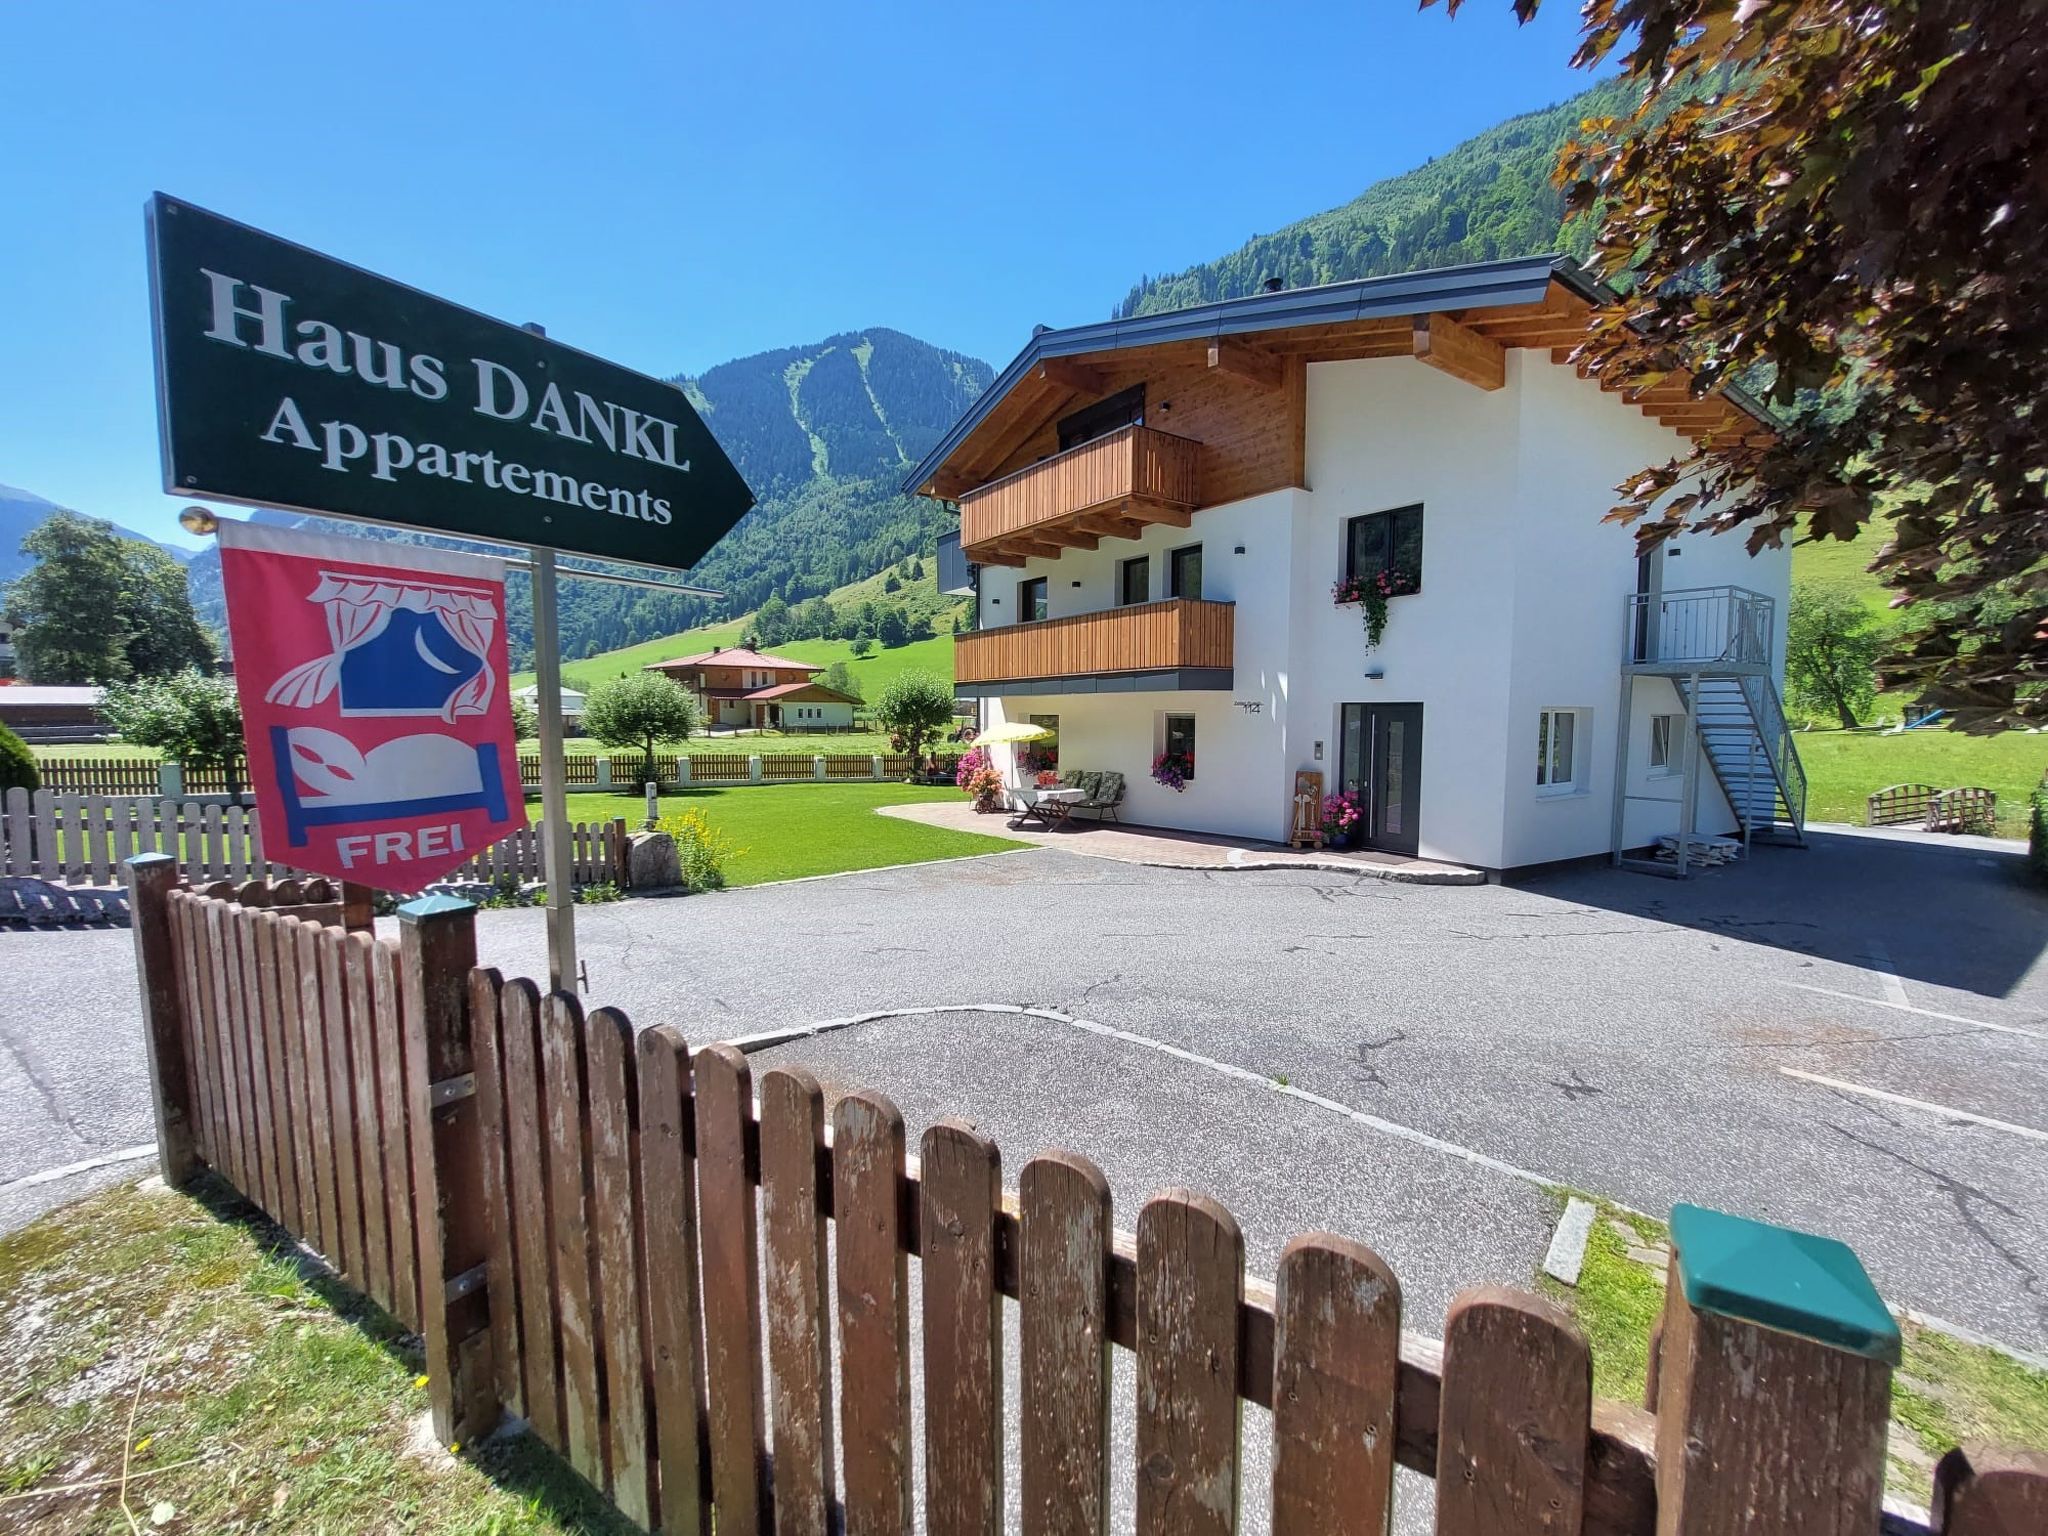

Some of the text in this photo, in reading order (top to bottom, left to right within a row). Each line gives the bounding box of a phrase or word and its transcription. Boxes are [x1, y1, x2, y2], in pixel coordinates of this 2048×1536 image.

[200, 267, 691, 473] Haus DANKL
[260, 396, 673, 526] Appartements
[1243, 703, 1261, 714] 114
[335, 823, 465, 870] FREI
